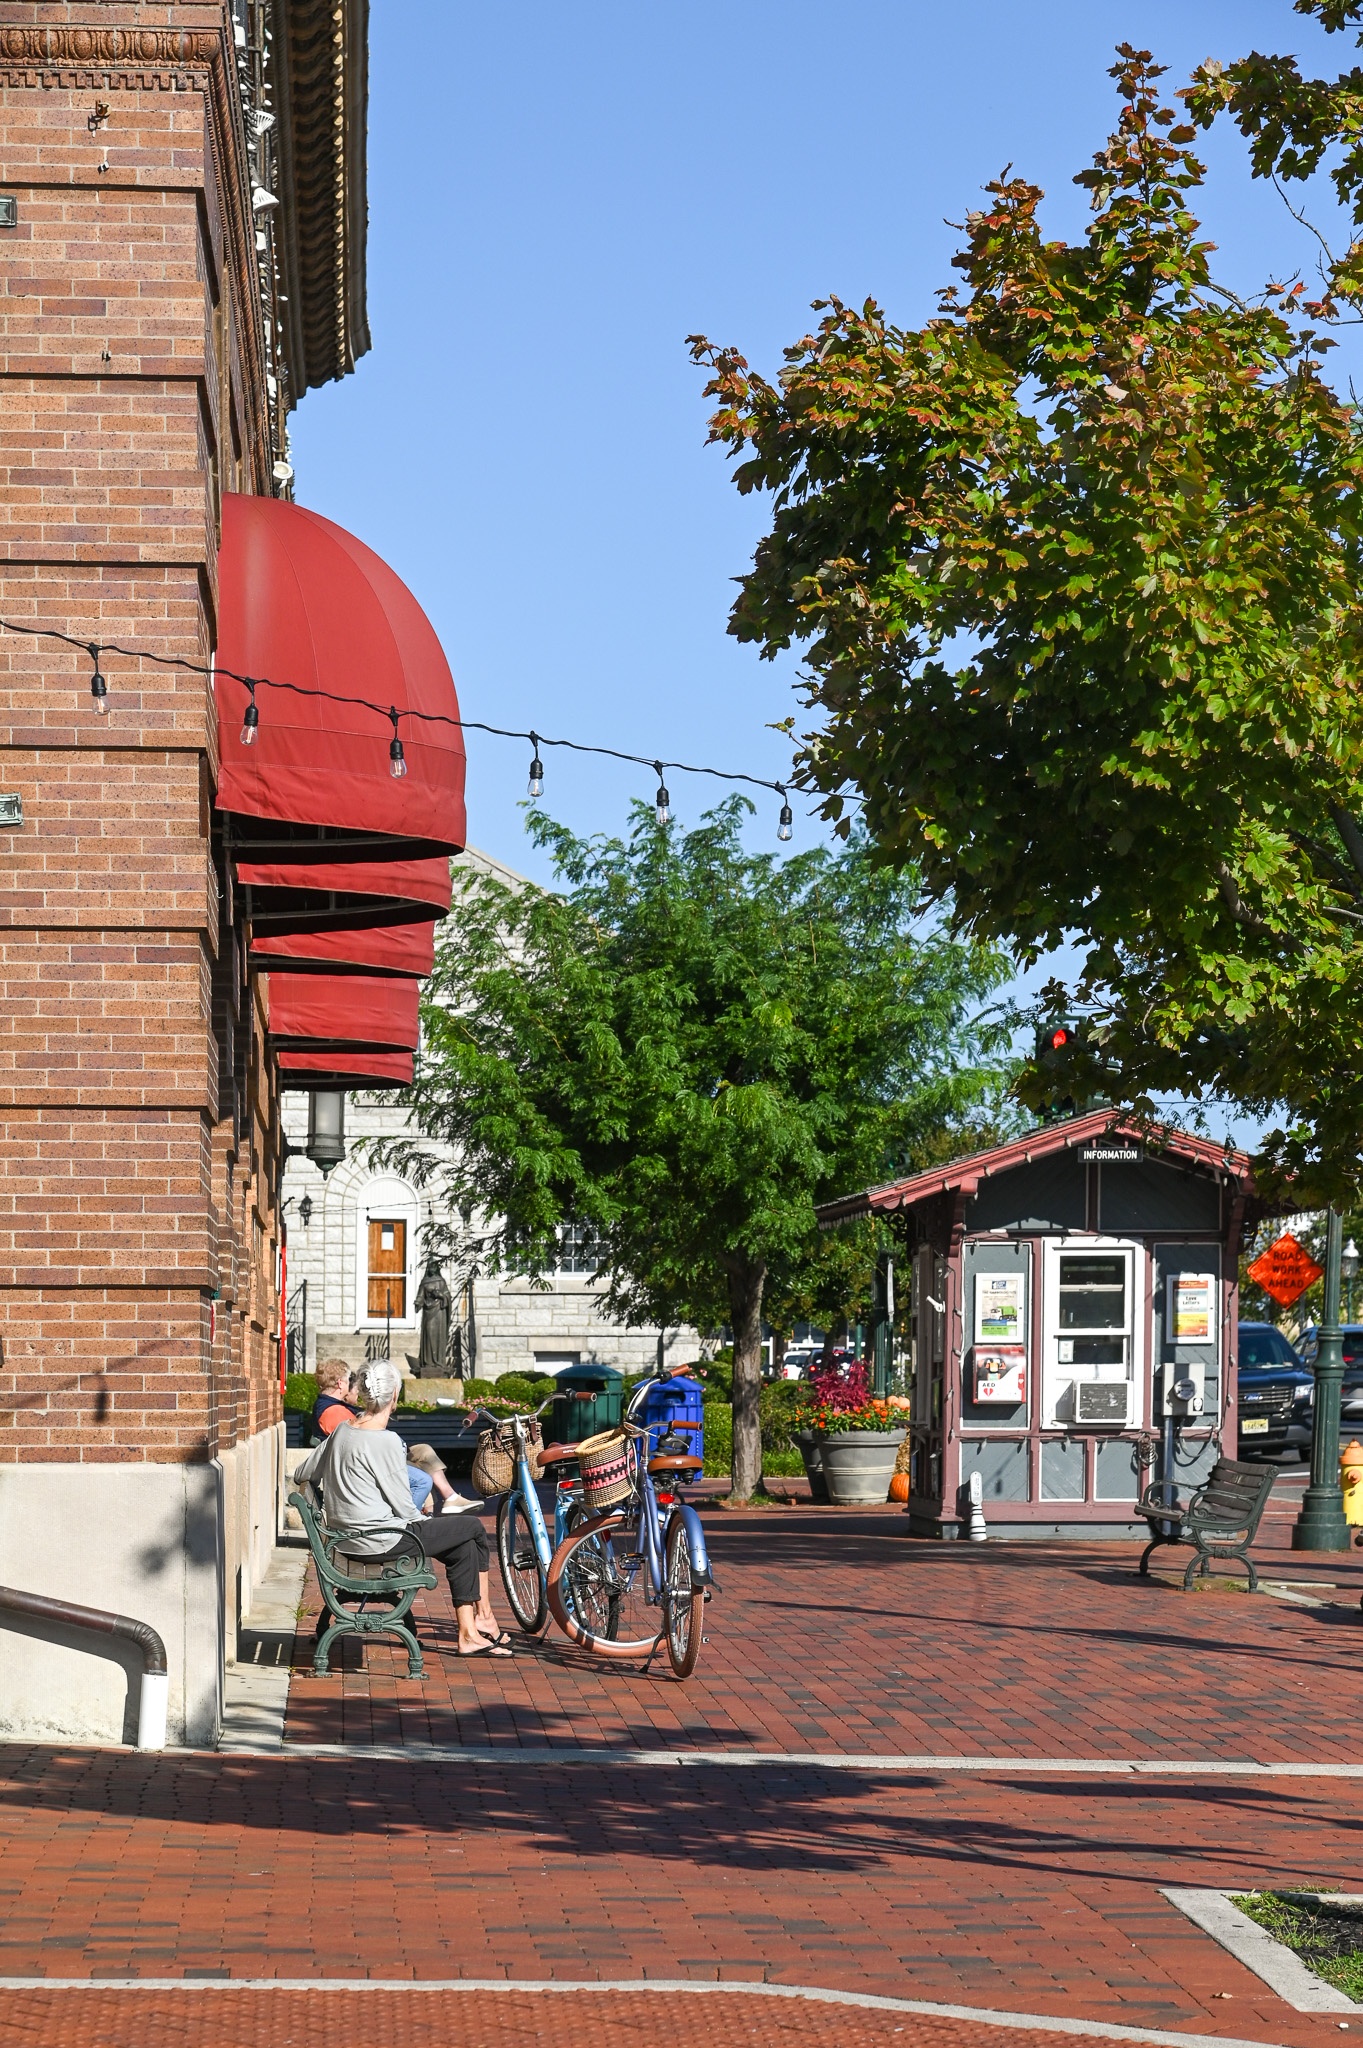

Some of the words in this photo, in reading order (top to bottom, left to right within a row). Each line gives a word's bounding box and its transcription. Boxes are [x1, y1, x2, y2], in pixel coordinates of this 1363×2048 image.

[1083, 1150, 1138, 1160] INFORMATION
[1273, 1251, 1302, 1260] ROAD
[1272, 1265, 1301, 1274] WORK
[1268, 1279, 1304, 1289] AHEAD
